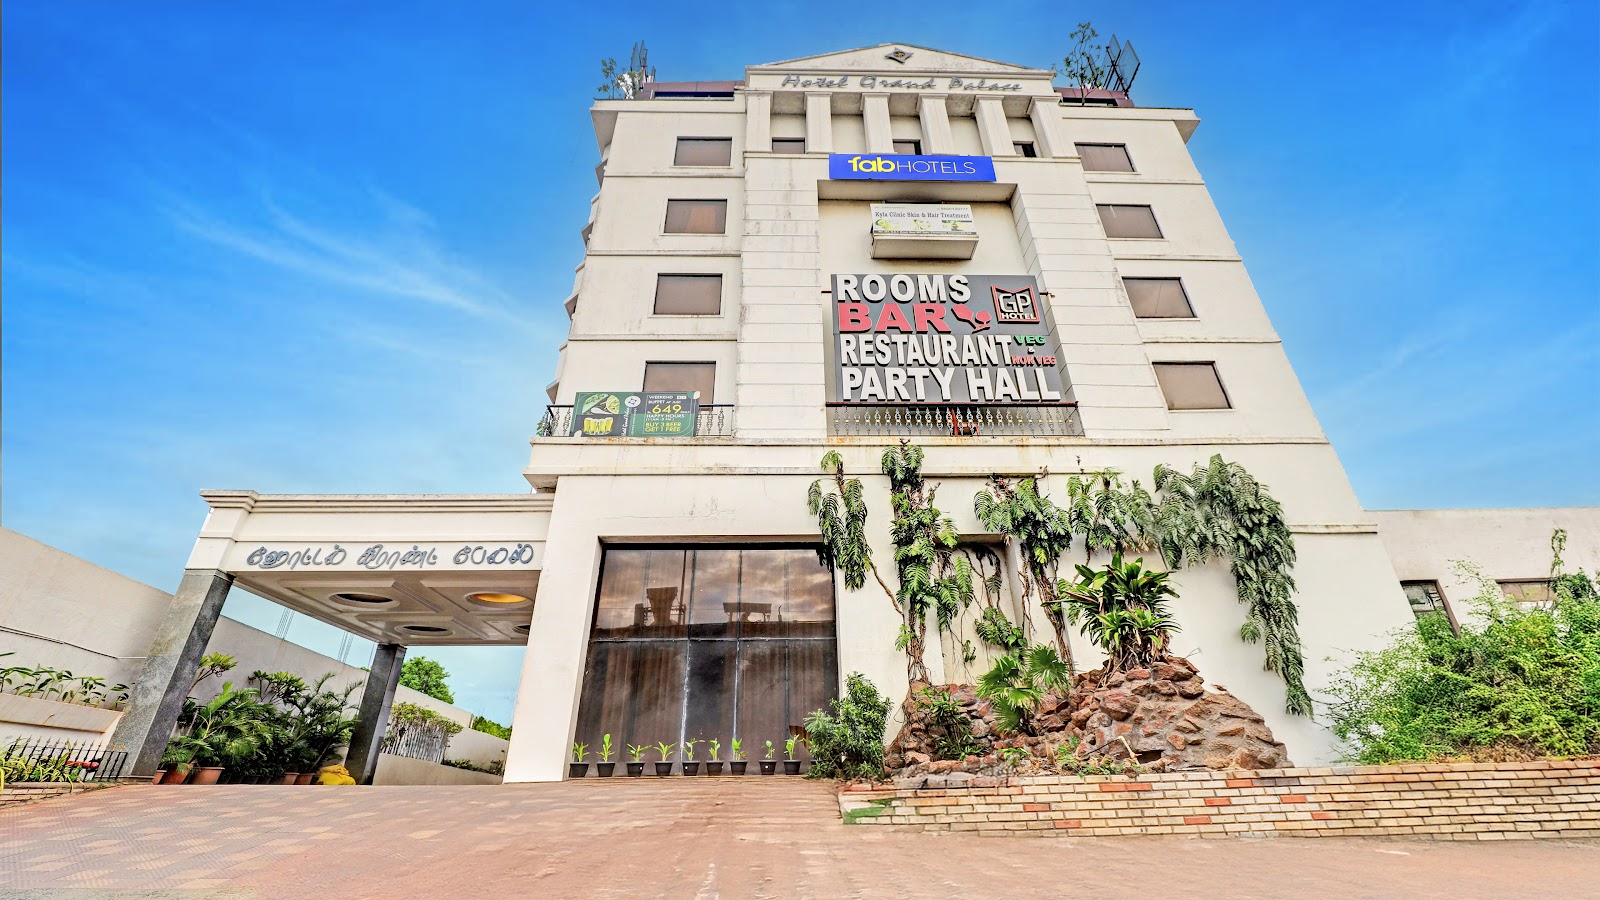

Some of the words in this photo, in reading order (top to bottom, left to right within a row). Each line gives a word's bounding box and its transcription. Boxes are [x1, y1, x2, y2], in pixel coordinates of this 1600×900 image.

[782, 74, 848, 88] Hotel
[860, 75, 936, 89] Grand
[948, 76, 1022, 91] Palace
[875, 211, 888, 219] Kyla
[836, 274, 971, 303] ROOMS
[999, 292, 1031, 313] GP
[838, 302, 952, 334] BAR
[1000, 312, 1036, 321] HOTEL
[1014, 335, 1047, 346] VEG
[840, 334, 1012, 367] RESTAURANT
[1027, 345, 1036, 354] &
[1034, 355, 1057, 367] VEG
[841, 367, 955, 402] PARTY
[966, 367, 1061, 402] HALL
[652, 404, 682, 414] 649
[246, 544, 347, 570] ஹோட்டல்
[356, 543, 438, 569] கிராண்ட்
[453, 543, 534, 566] பேலஸ்
